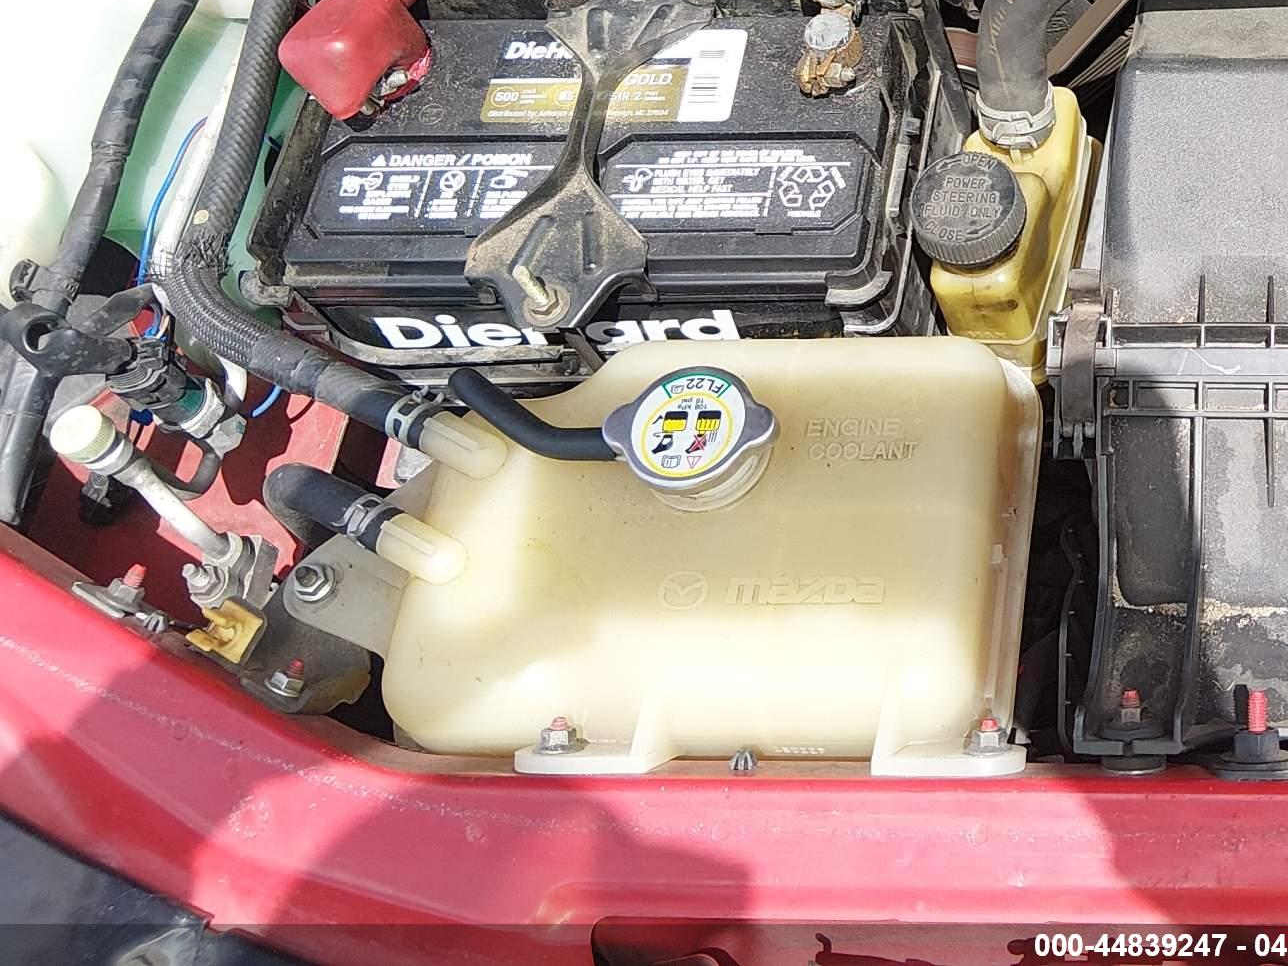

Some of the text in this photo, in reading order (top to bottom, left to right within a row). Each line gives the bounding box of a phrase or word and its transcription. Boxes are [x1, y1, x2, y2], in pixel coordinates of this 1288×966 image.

[625, 73, 672, 86] GOLD
[494, 91, 520, 102] 500
[389, 154, 457, 166] DANGER
[471, 153, 532, 166] POISON
[962, 154, 996, 172] OPEN
[650, 184, 733, 194] MEDICAL HELP FAST
[945, 177, 986, 190] POWER
[932, 190, 998, 204] STEERING
[923, 204, 1001, 219] FLUID ONLY
[924, 220, 966, 242] CLOSE
[686, 377, 724, 394] FL22
[805, 418, 899, 437] ENGINE
[809, 441, 919, 461] COOLANT
